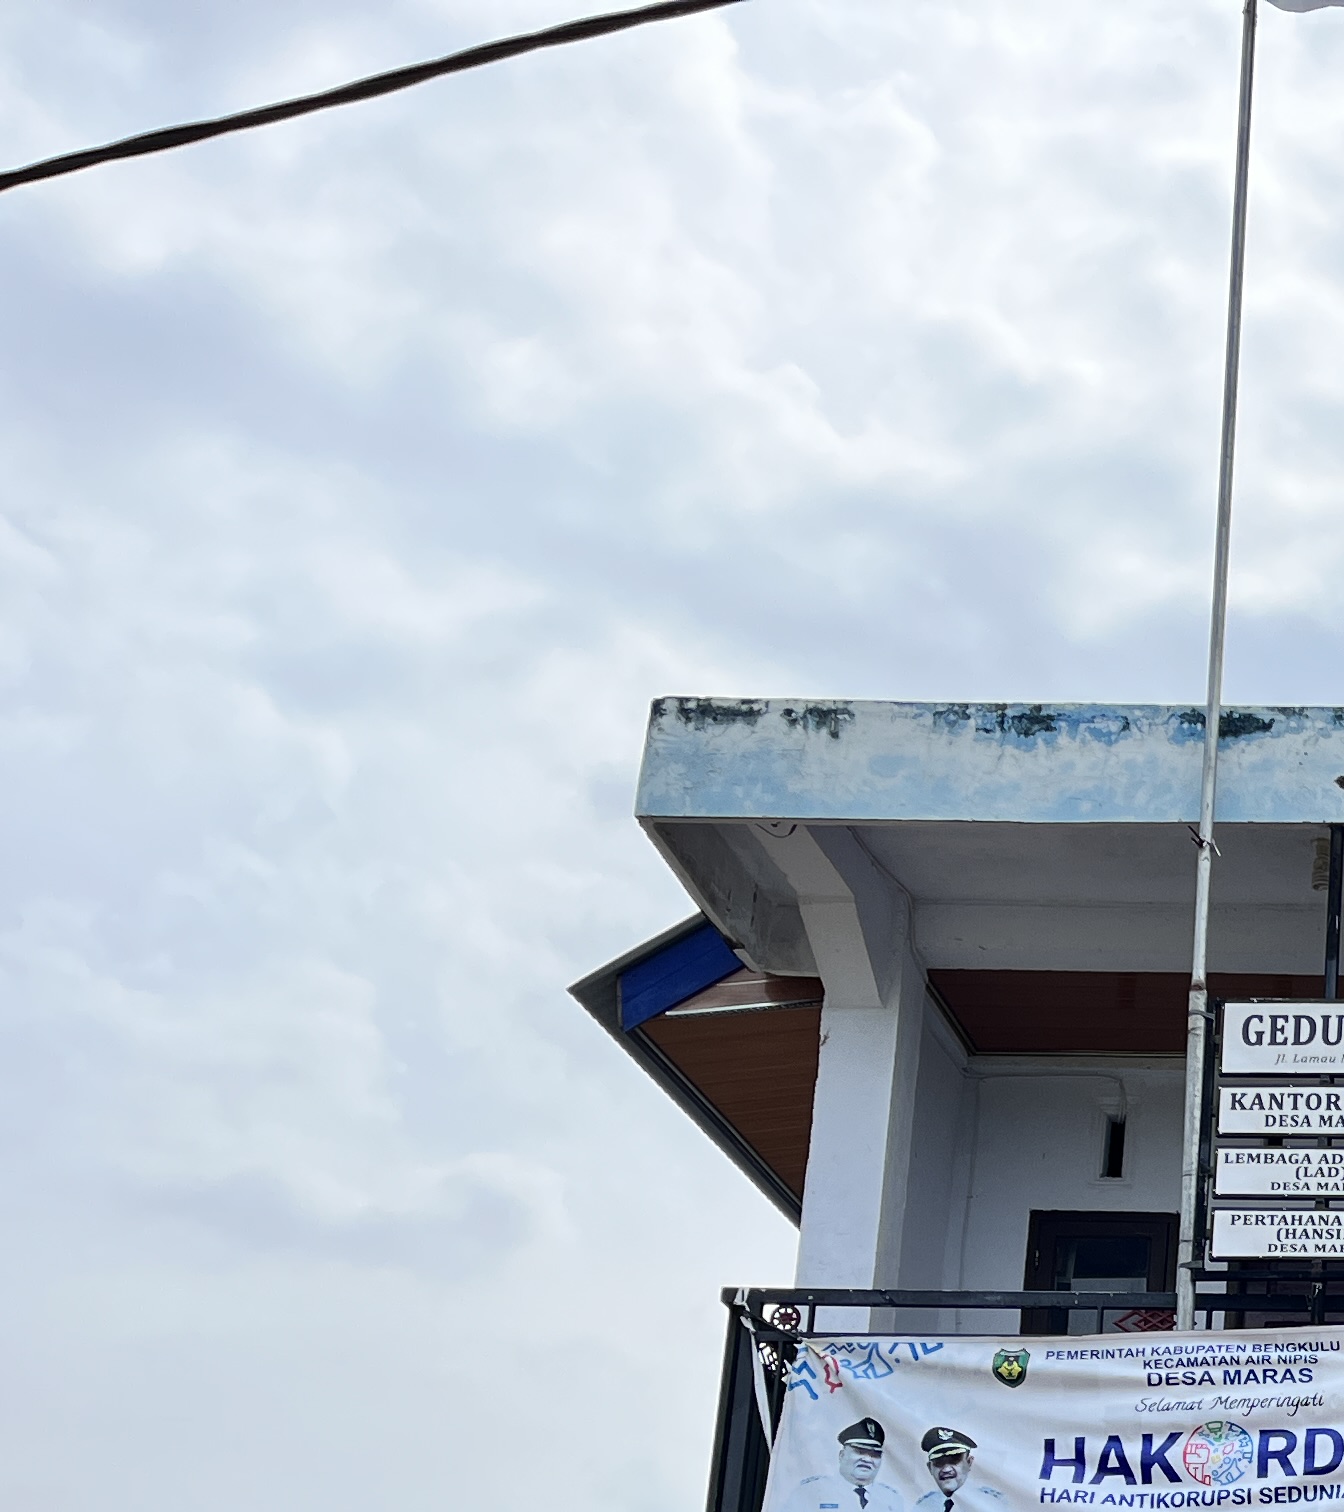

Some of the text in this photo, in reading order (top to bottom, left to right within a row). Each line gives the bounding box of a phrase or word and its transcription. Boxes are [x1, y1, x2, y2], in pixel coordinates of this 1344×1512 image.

[1229, 1092, 1343, 1111] KANTOR
[1264, 1114, 1313, 1128] DESA
[1224, 1152, 1313, 1165] LEMBAGA
[1270, 1182, 1311, 1191] DESA
[1267, 1243, 1308, 1253] DESA
[1045, 1347, 1146, 1361] PEMERINTAH
[1150, 1344, 1247, 1357] KABUPATEN
[1251, 1340, 1341, 1354] BENGKULU
[1142, 1353, 1319, 1370] KECAMATAN AIR NIPIS
[1146, 1368, 1314, 1387] DESA MARAS
[1134, 1392, 1325, 1417] Selamat Memperingati
[1040, 1487, 1096, 1504] HARI
[1100, 1487, 1252, 1509] ANTIKORUPSI
